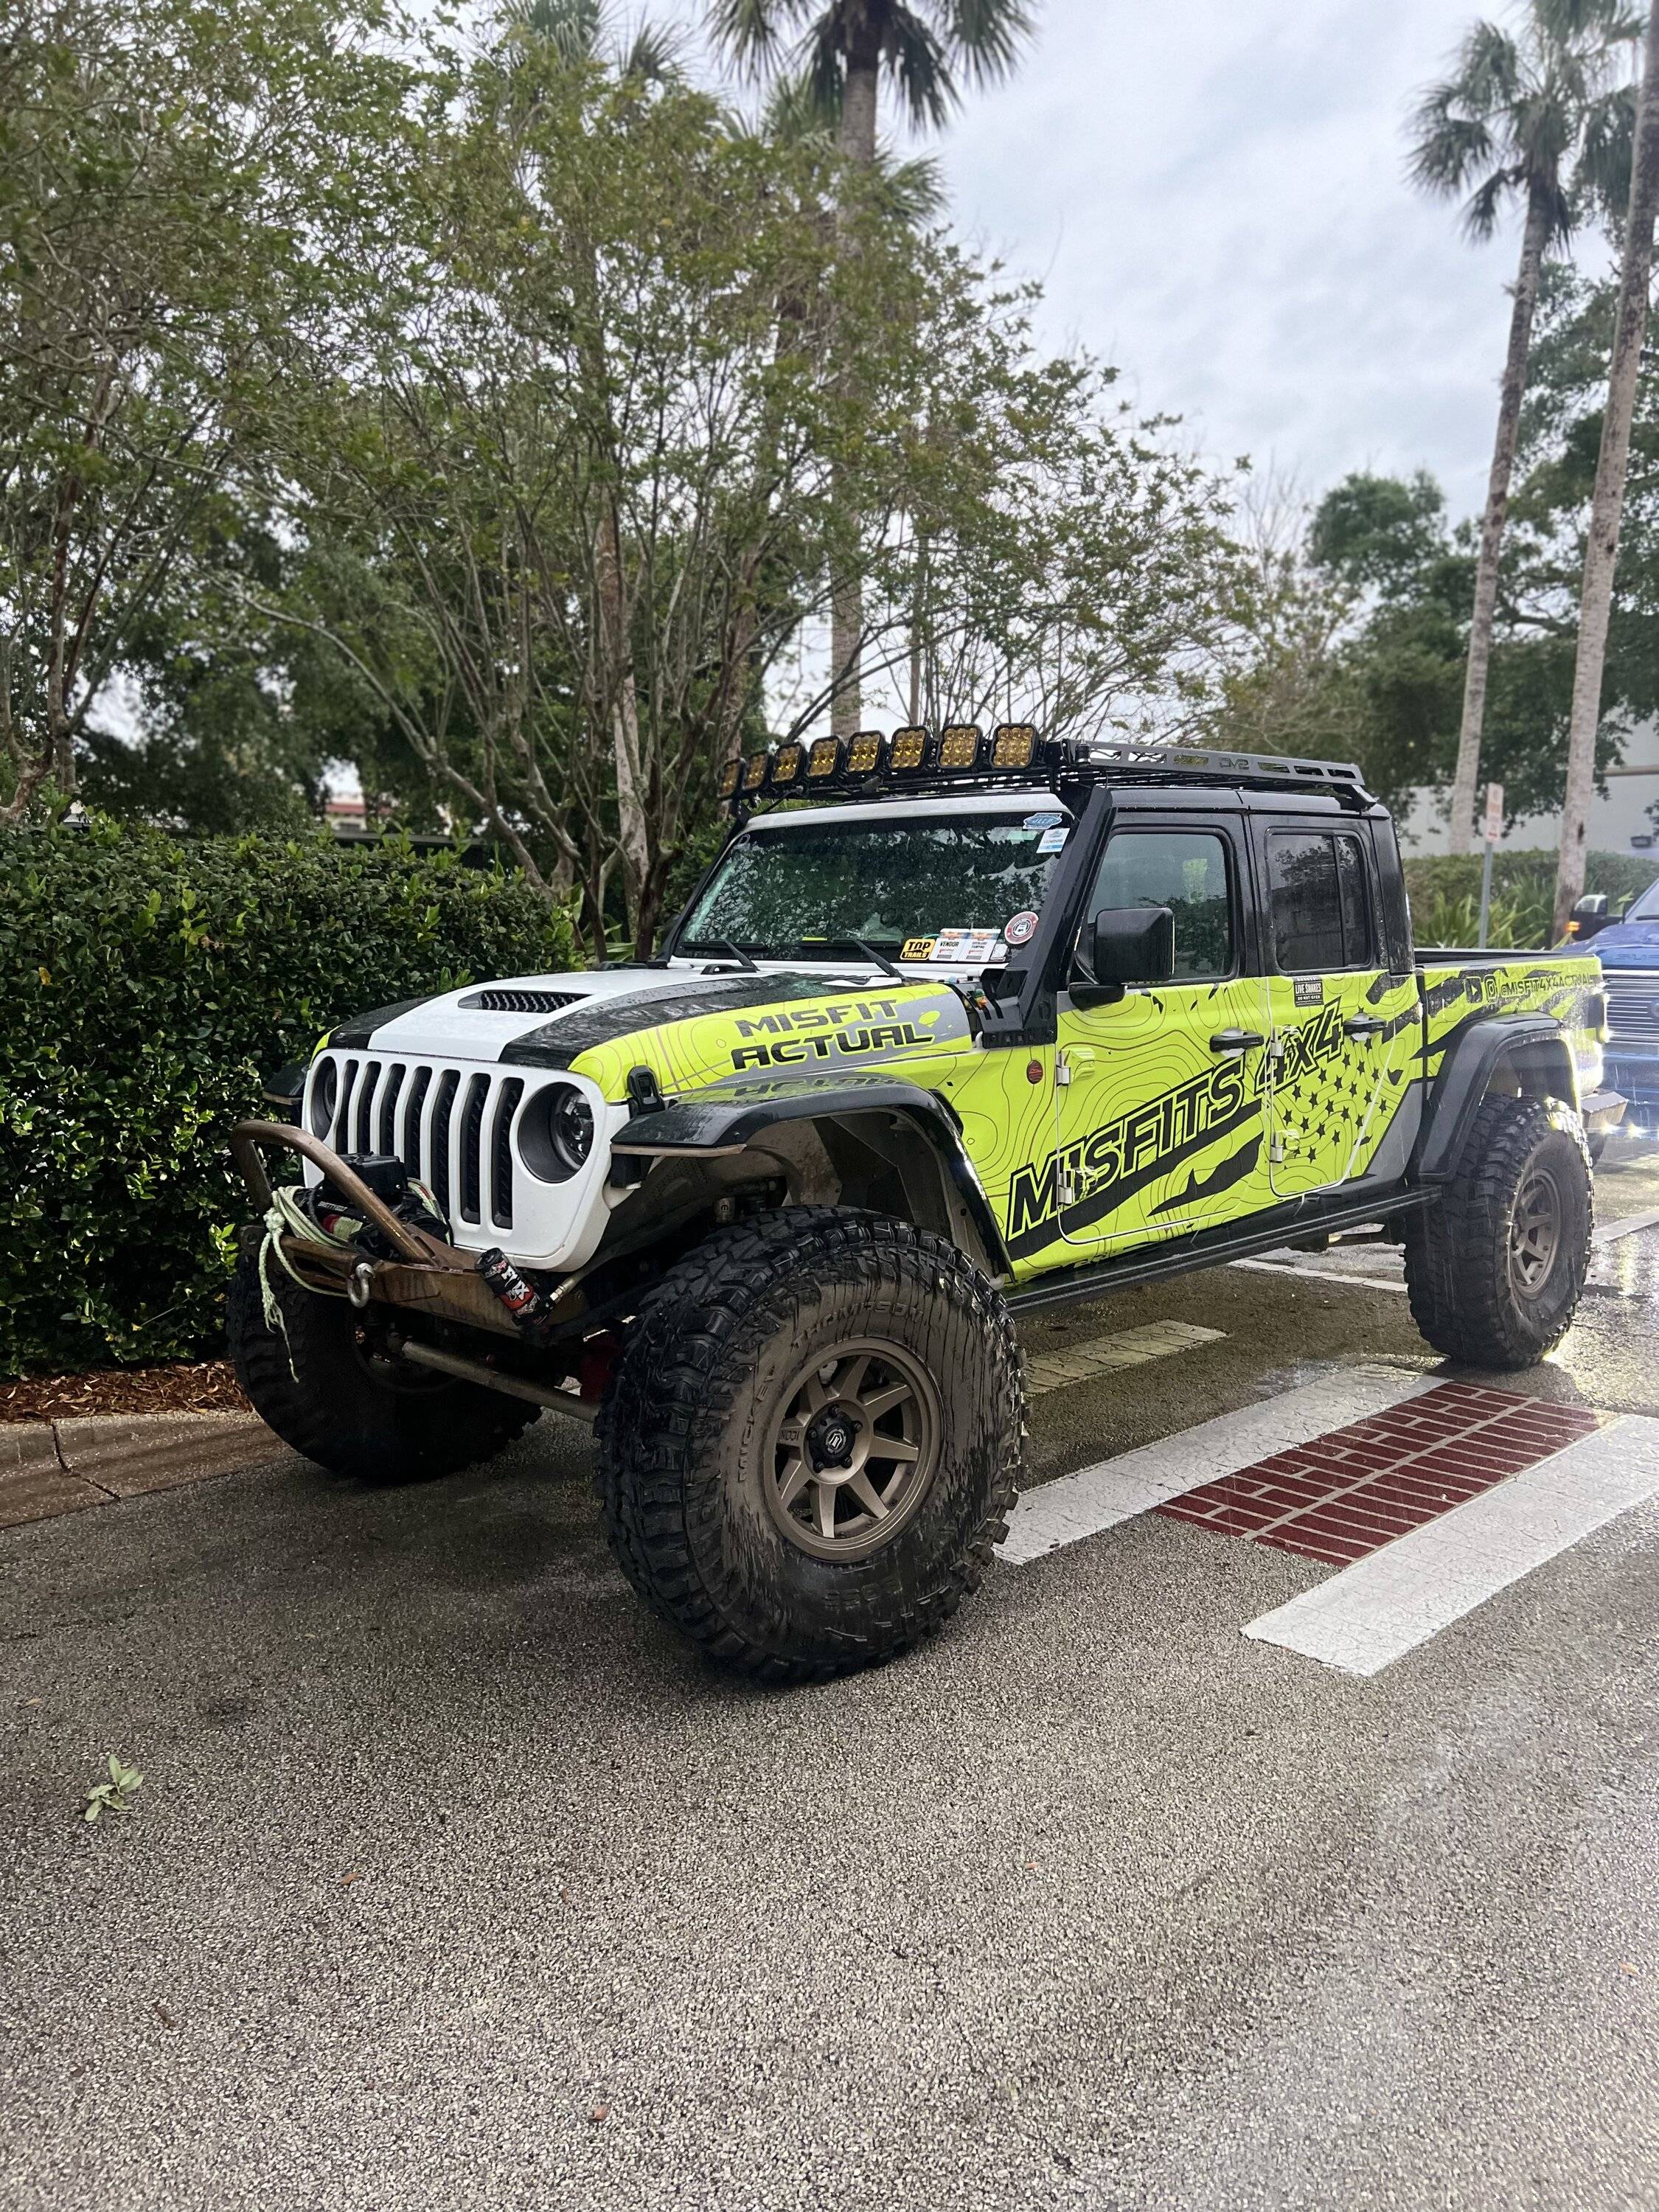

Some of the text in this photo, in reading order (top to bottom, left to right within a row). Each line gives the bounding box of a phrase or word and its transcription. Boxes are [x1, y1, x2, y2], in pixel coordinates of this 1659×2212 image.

[908, 941, 931, 951] TOP
[1295, 982, 1321, 994] LIVE SNAKES
[734, 999, 897, 1037] MISFIT
[731, 1023, 934, 1071] ACTUAL
[1007, 1055, 1244, 1241] MISFITS
